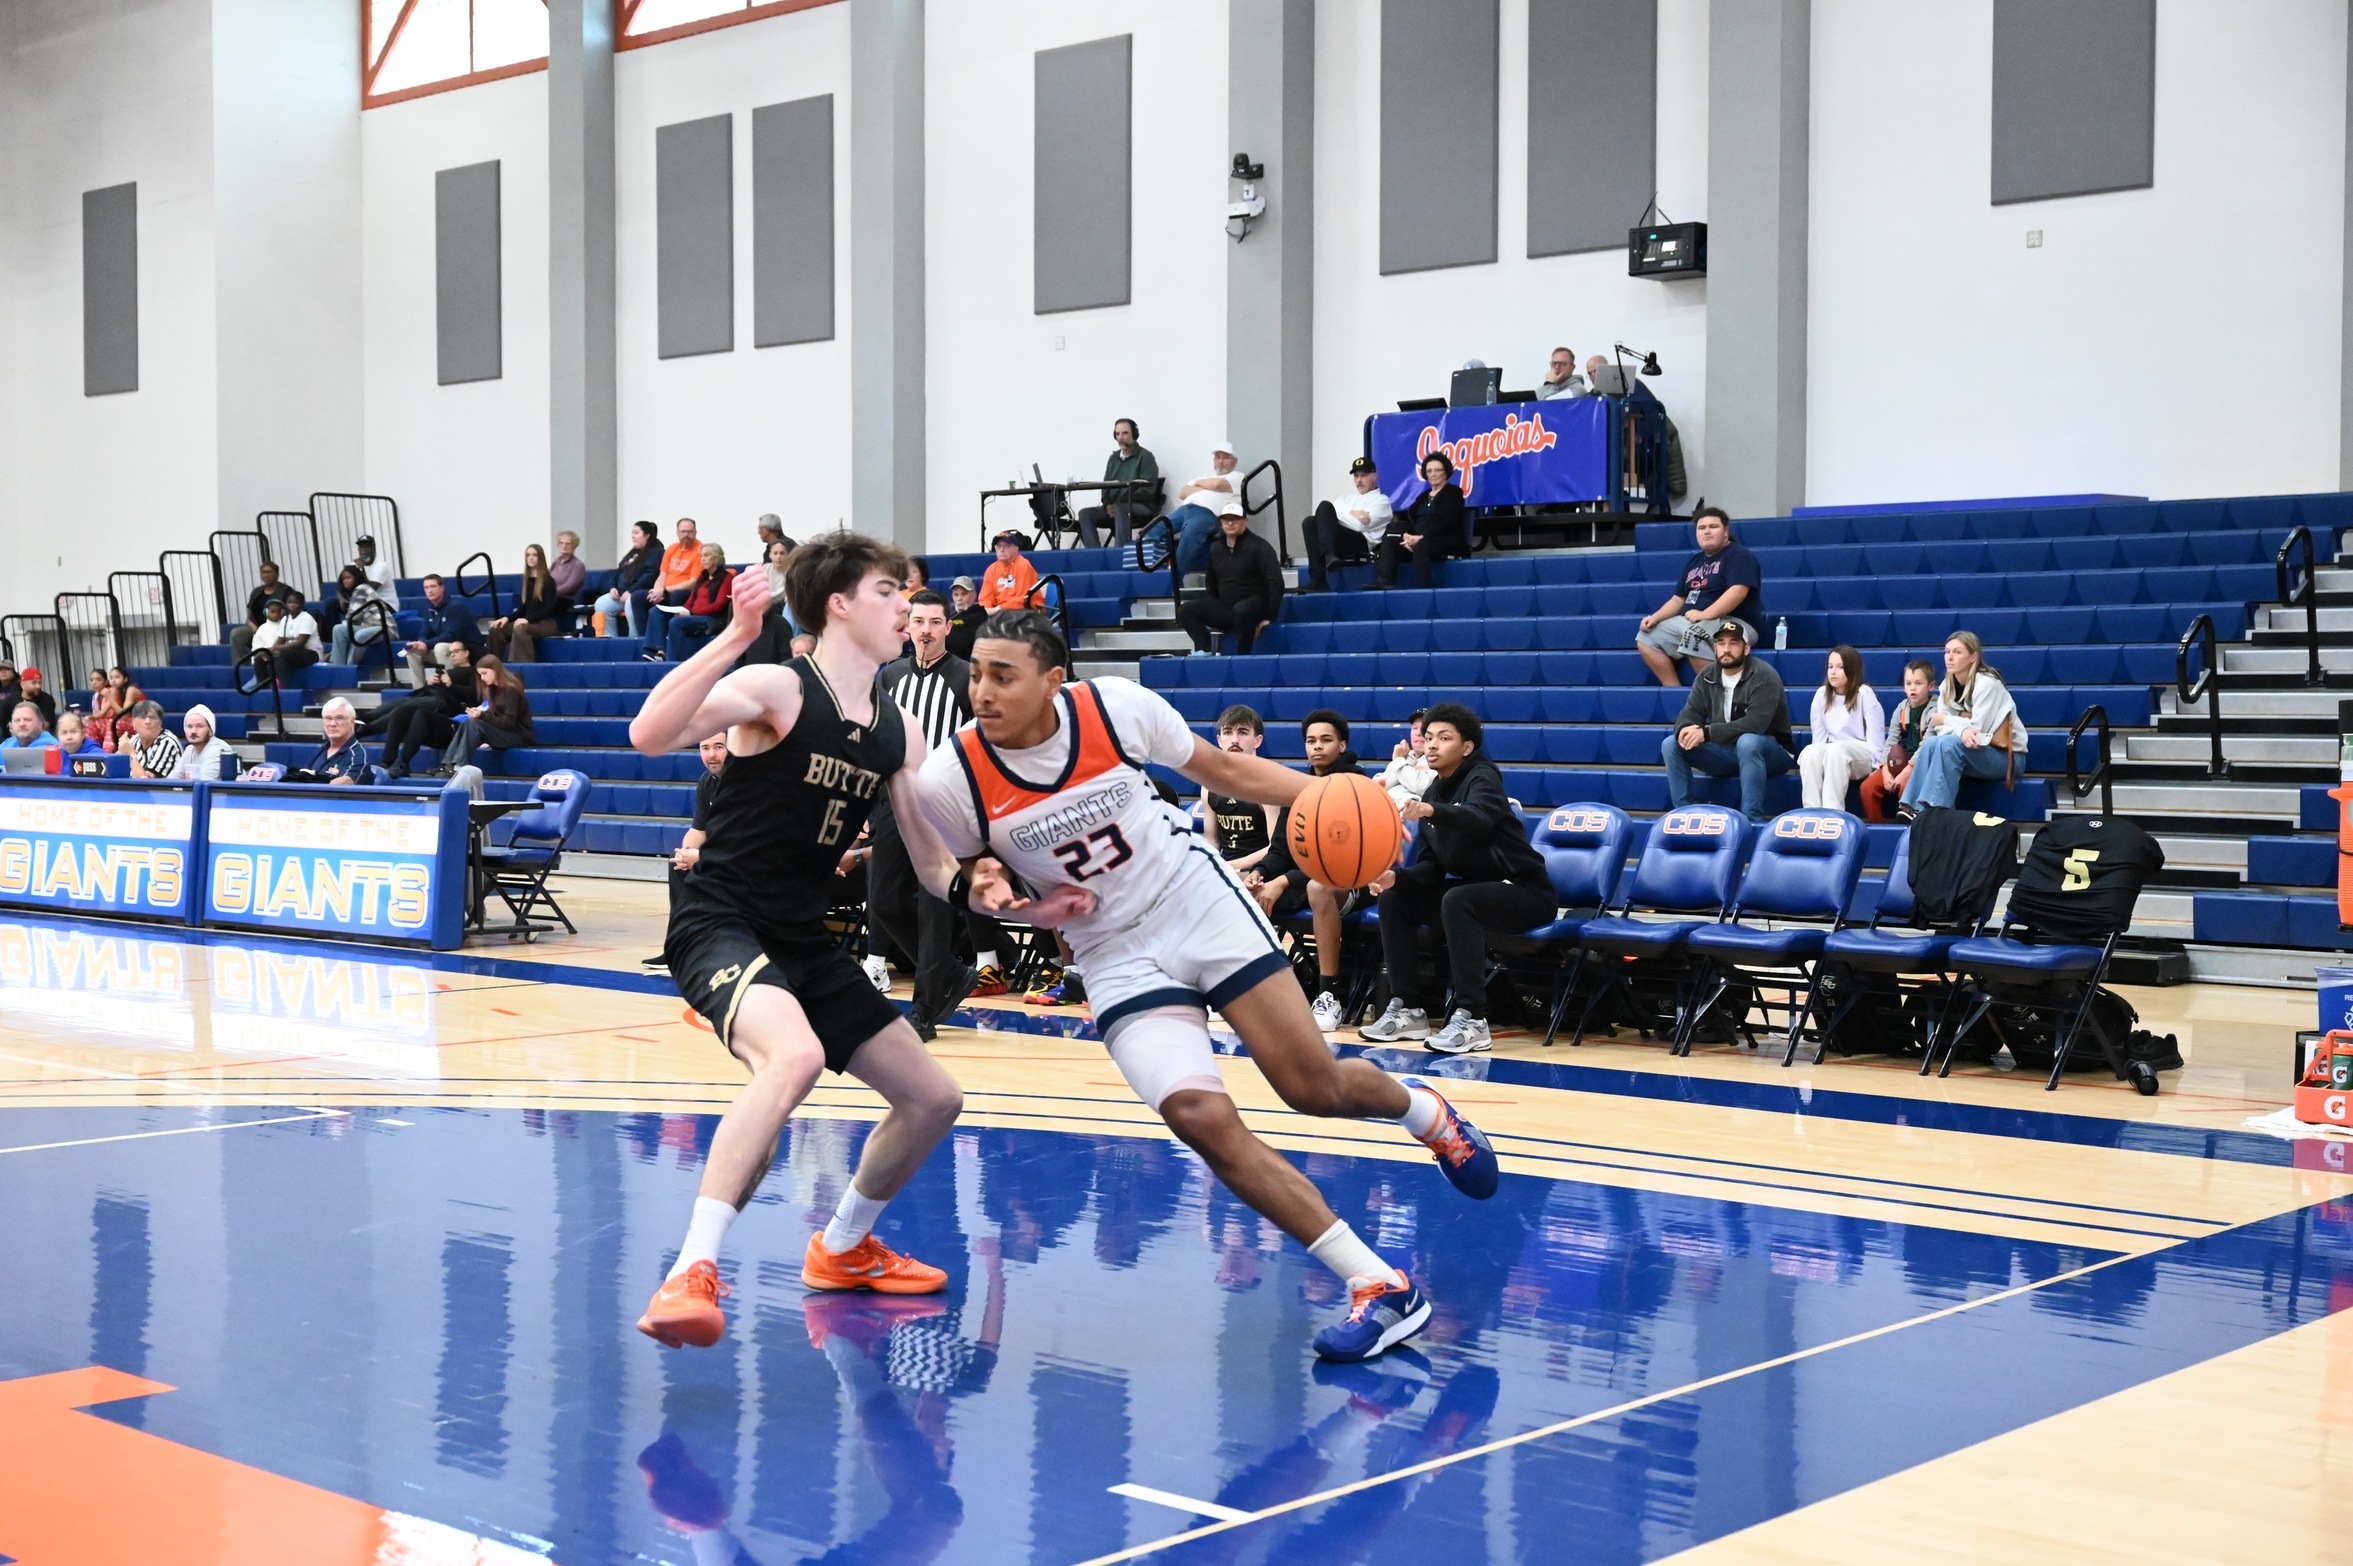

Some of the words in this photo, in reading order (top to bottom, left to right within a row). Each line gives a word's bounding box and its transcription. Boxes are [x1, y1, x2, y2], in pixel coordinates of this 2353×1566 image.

[1416, 412, 1557, 498] Sequoias
[803, 752, 881, 799] BUTTE
[18, 803, 79, 828] HOME
[89, 807, 117, 830] OF
[124, 808, 167, 833] THE
[238, 815, 307, 842] HOME
[319, 818, 351, 844] OF
[360, 820, 410, 847] THE
[817, 798, 848, 845] 15
[1009, 781, 1132, 852] GIANTS
[1548, 810, 1611, 832] COS
[1663, 813, 1729, 835] COS
[1774, 815, 1846, 840] COS
[0, 837, 184, 908] GIANTS
[1053, 822, 1134, 882] 23
[2060, 848, 2100, 892] 5
[212, 852, 430, 929] GIANTS
[2324, 1095, 2347, 1121] G
